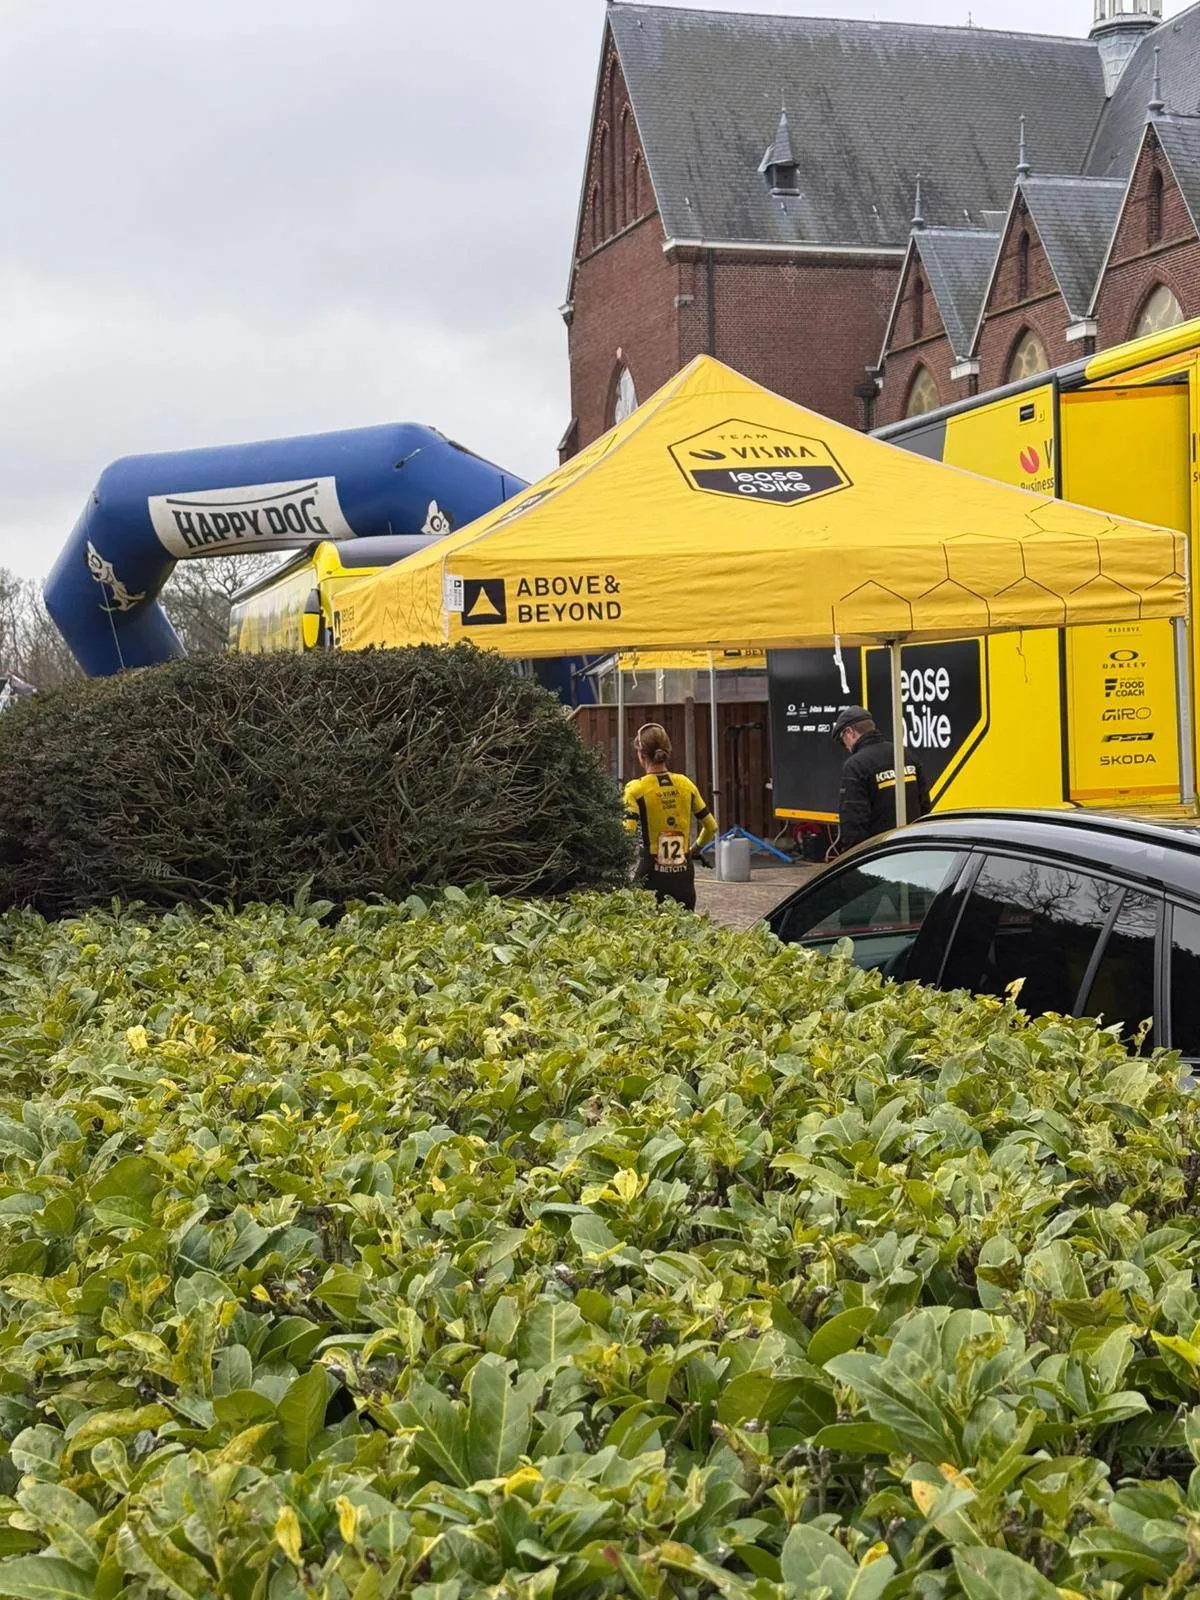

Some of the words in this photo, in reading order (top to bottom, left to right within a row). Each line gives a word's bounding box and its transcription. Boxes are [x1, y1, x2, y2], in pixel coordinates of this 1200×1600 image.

[717, 433, 769, 441] TEAM
[730, 446, 817, 459] VISMA
[1044, 438, 1053, 469] V
[728, 471, 804, 483] lease
[171, 509, 264, 549] HAPPY
[262, 496, 330, 535] DOG
[518, 601, 622, 624] BEYOND
[900, 667, 950, 702] ease
[1119, 681, 1145, 690] FOOD
[1115, 689, 1145, 697] COACH
[661, 840, 682, 860] 12
